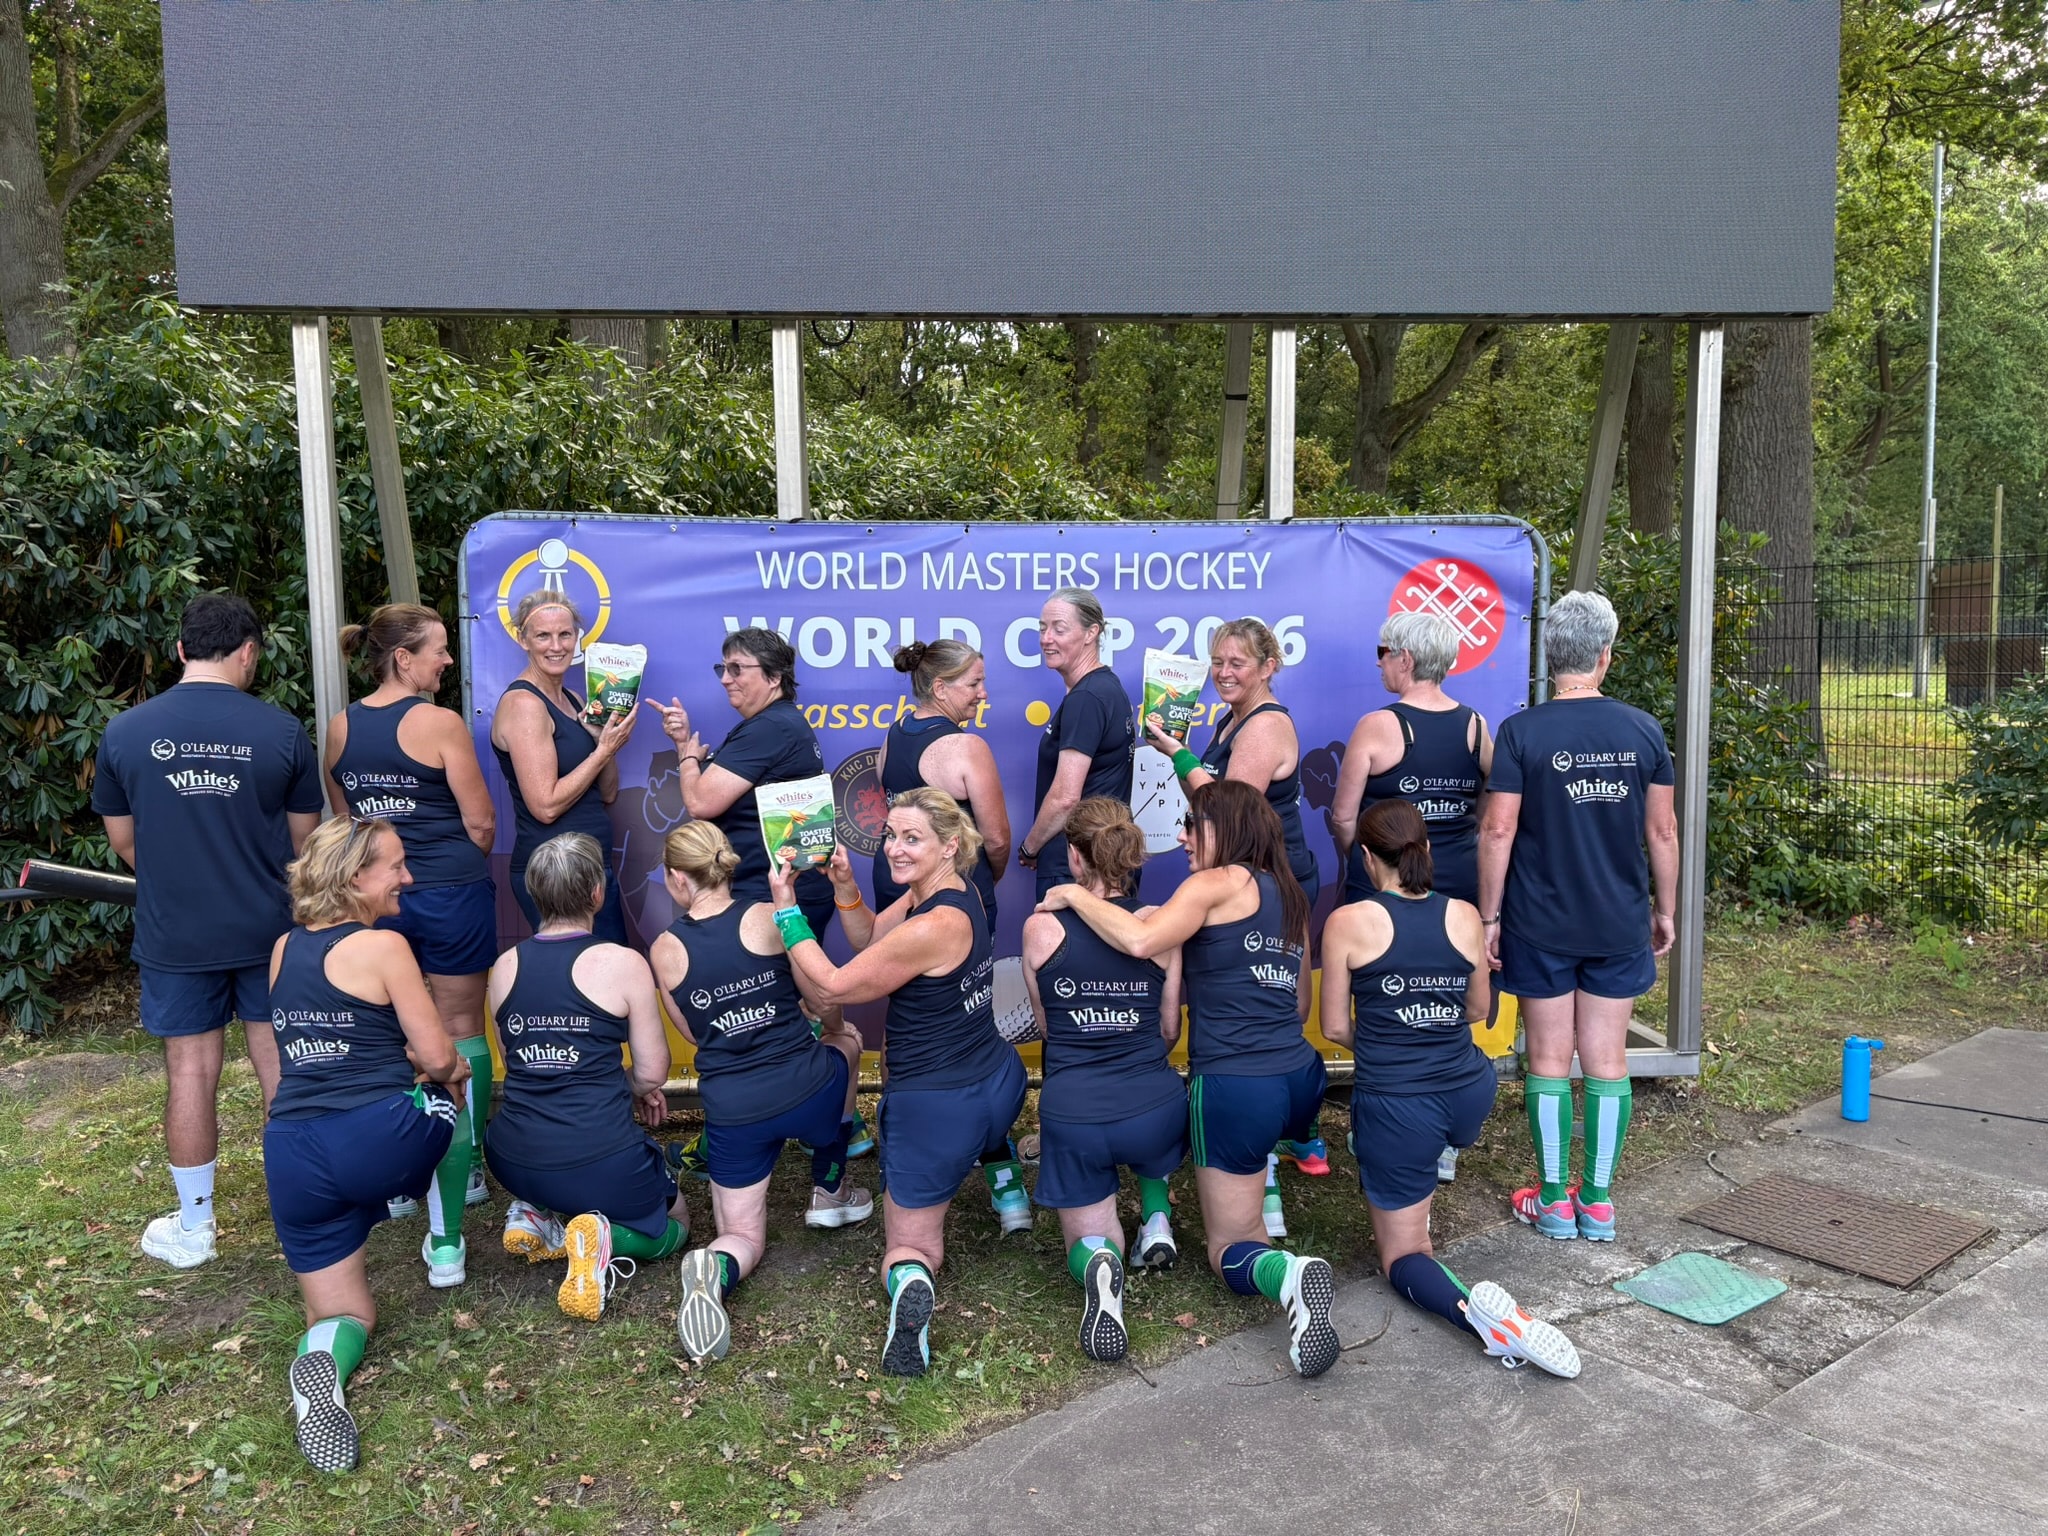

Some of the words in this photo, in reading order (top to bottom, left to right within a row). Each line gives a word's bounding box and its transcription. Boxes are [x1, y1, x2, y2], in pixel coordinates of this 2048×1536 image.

[755, 551, 907, 590] WORLD
[922, 551, 1100, 591] MASTERS
[1115, 551, 1271, 591] HOCKEY
[1004, 616, 1135, 668] CP
[598, 655, 631, 668] White's
[1159, 668, 1189, 680] White's
[607, 696, 634, 707] OATS
[1168, 710, 1192, 722] OATS
[180, 742, 229, 754] O'LEARY
[232, 745, 252, 757] LIFE
[1576, 752, 1616, 763] O'LEARY
[1618, 752, 1637, 762] LIFE
[840, 760, 863, 781] KHC
[165, 769, 240, 791] White's
[360, 773, 398, 783] O'LEARY
[401, 775, 418, 784] LIFE
[1423, 778, 1461, 787] O'LEARY
[1462, 779, 1476, 788] LIFE
[1565, 778, 1629, 798] White's
[775, 790, 813, 804] White's
[356, 795, 416, 815] White's
[799, 827, 831, 837] TOASTED
[838, 821, 860, 843] HOC
[800, 833, 833, 846] OATS
[713, 976, 756, 997] O'LEARY
[758, 969, 776, 984] LIFE
[1080, 981, 1128, 992] O'LEARY
[1130, 981, 1149, 992] LIFE
[1409, 976, 1451, 987] O'LEARY
[1452, 976, 1467, 987] LIFE
[288, 1010, 329, 1022] O'LEARY
[331, 1012, 354, 1022] LIFE
[709, 1001, 776, 1032] White's
[1067, 1007, 1140, 1026] White's
[1394, 1002, 1461, 1023] White's
[527, 1015, 568, 1026] O'LEARY
[570, 1016, 590, 1027] LIFE
[284, 1037, 350, 1060] White's
[516, 1043, 580, 1063] White's
